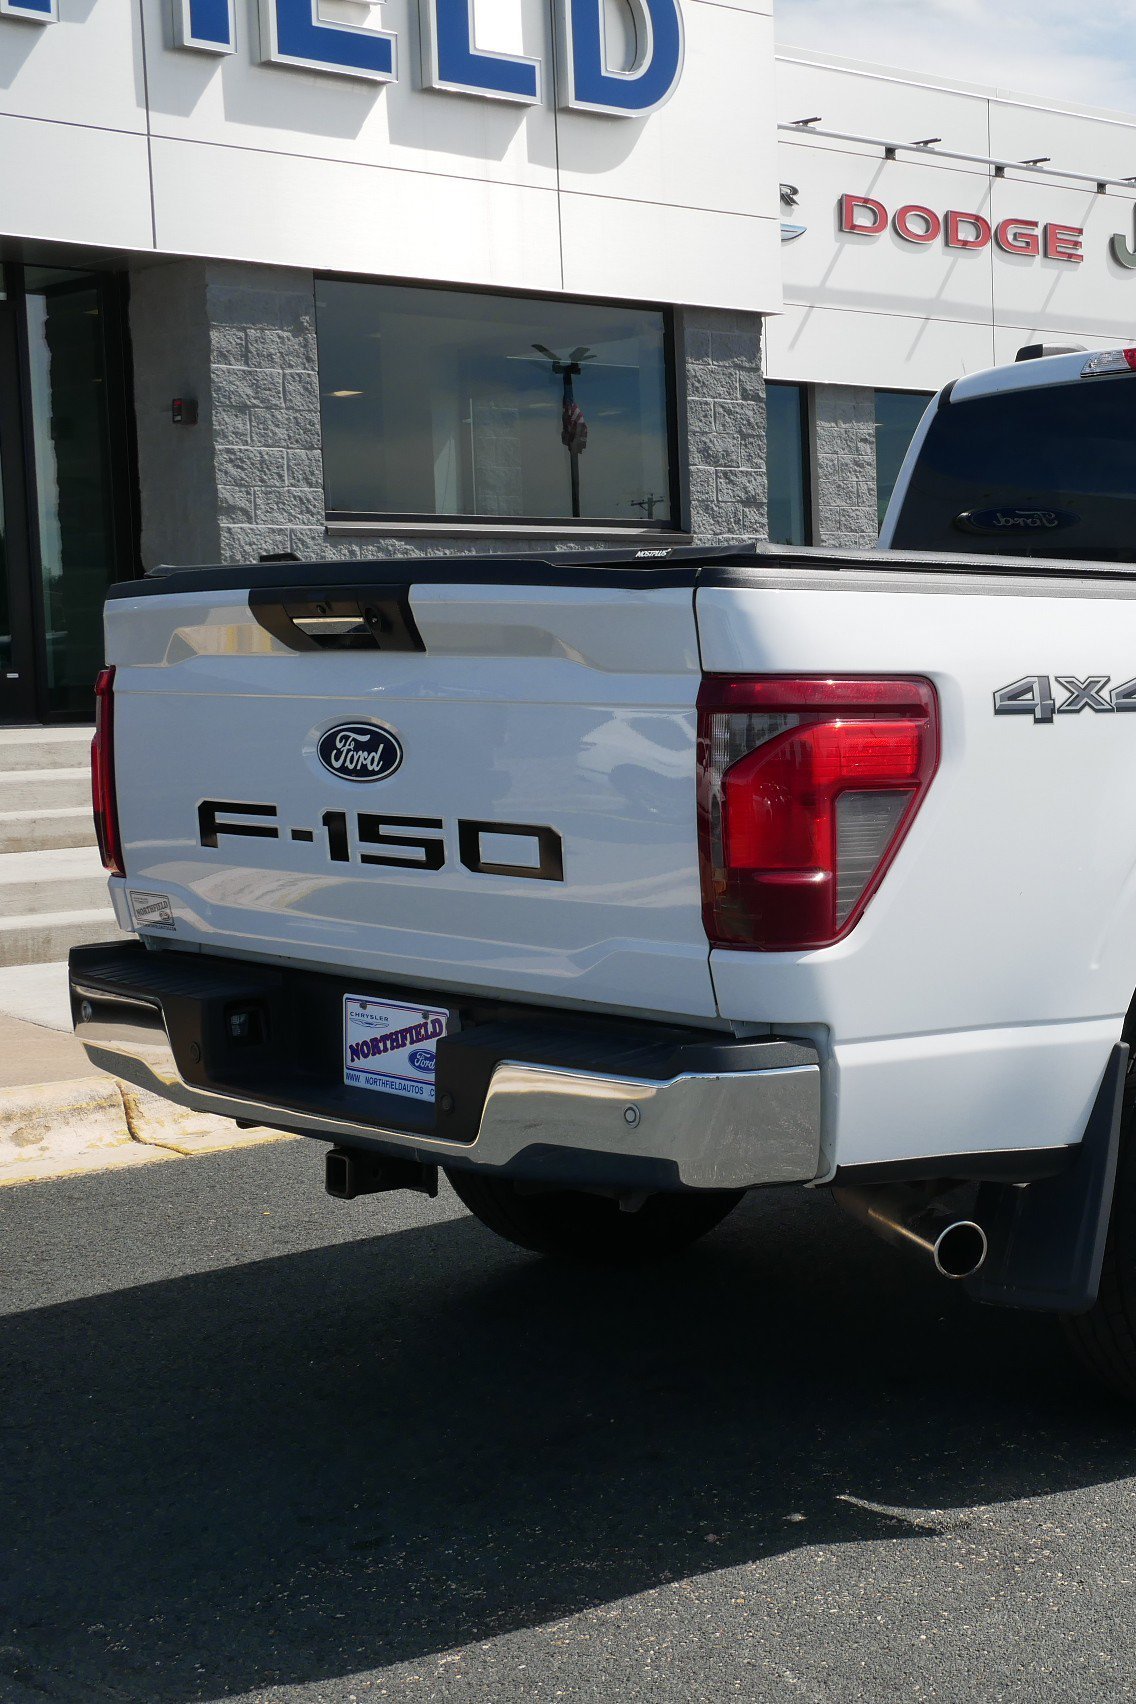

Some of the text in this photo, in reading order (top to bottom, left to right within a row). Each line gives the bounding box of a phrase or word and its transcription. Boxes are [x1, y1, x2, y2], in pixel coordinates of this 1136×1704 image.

[841, 193, 1084, 264] DODGE
[331, 731, 384, 772] Ford
[197, 799, 564, 882] F-150
[350, 1011, 389, 1022] CHRYSLER
[349, 1018, 444, 1063] NORTHFIELD
